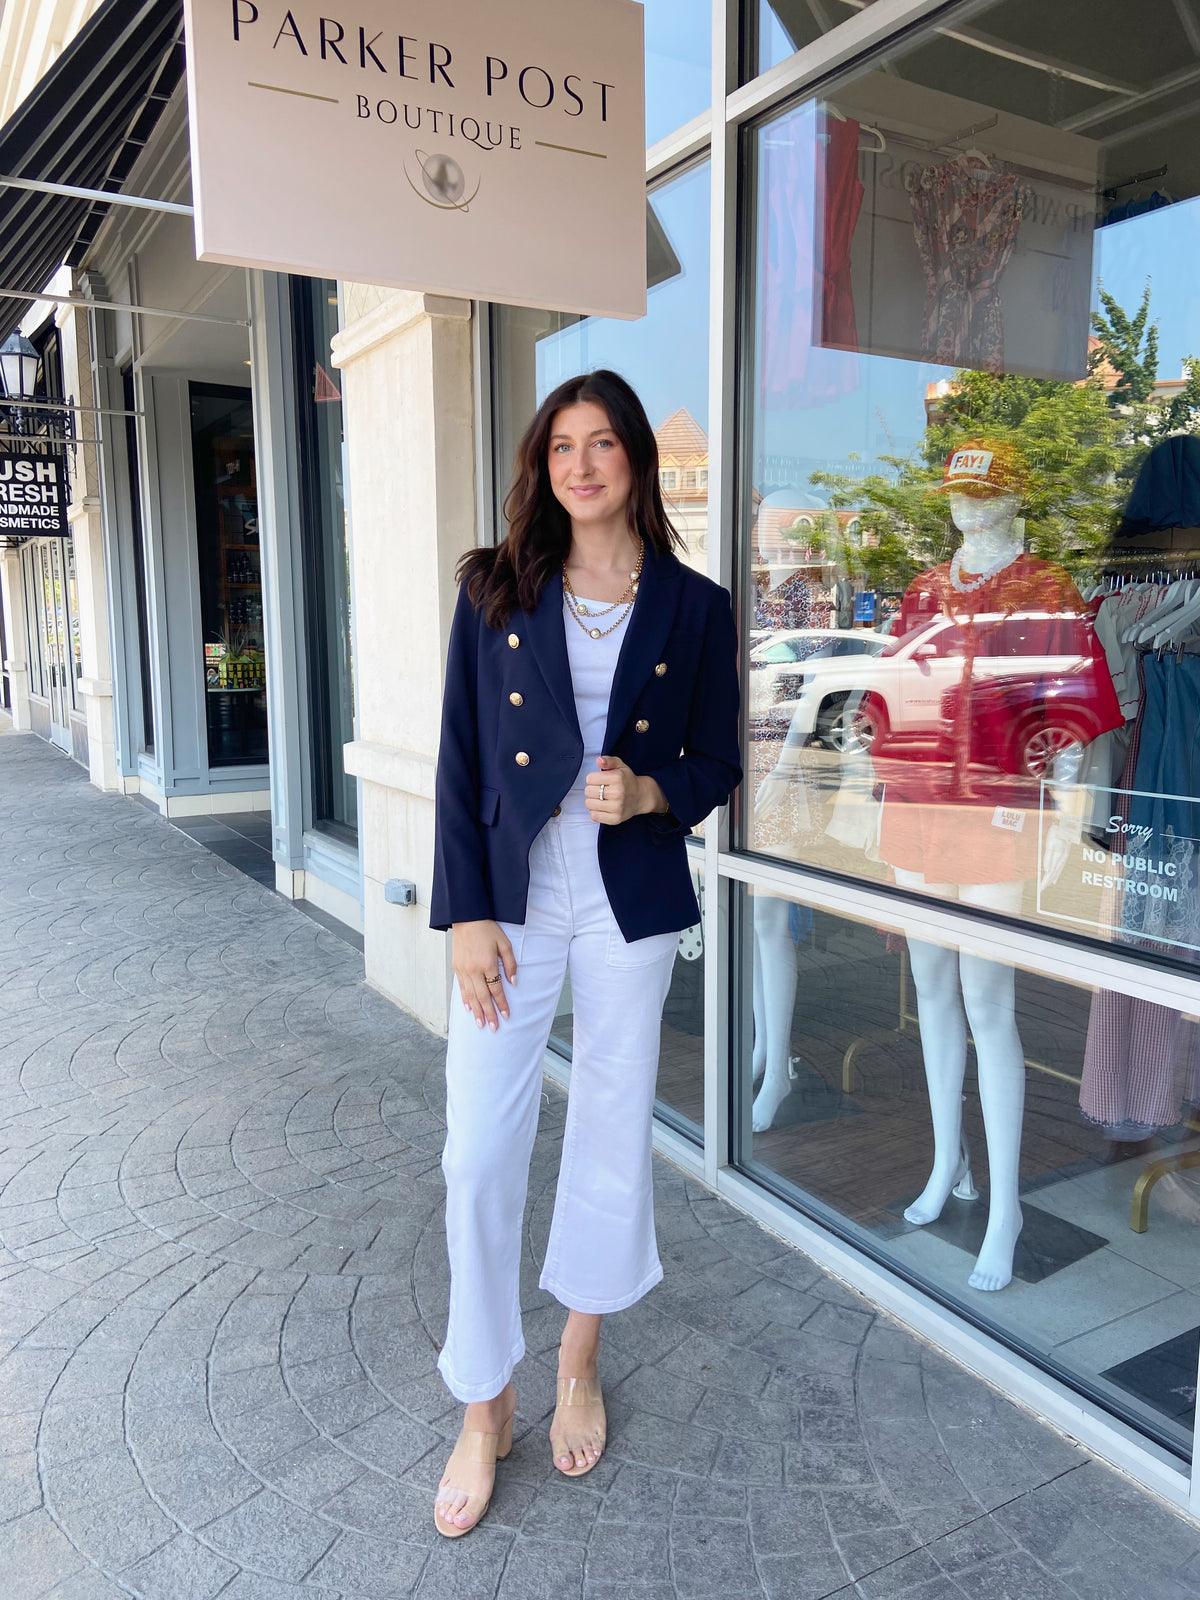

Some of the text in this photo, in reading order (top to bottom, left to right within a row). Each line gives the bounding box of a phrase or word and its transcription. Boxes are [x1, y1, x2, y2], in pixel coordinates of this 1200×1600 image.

[232, 0, 616, 122] PARKER POST
[355, 94, 522, 150] BOUTIQUE
[1105, 815, 1154, 842] Sorry
[1082, 847, 1177, 877] NO PUBLIC
[1081, 870, 1178, 902] RESTROOM
